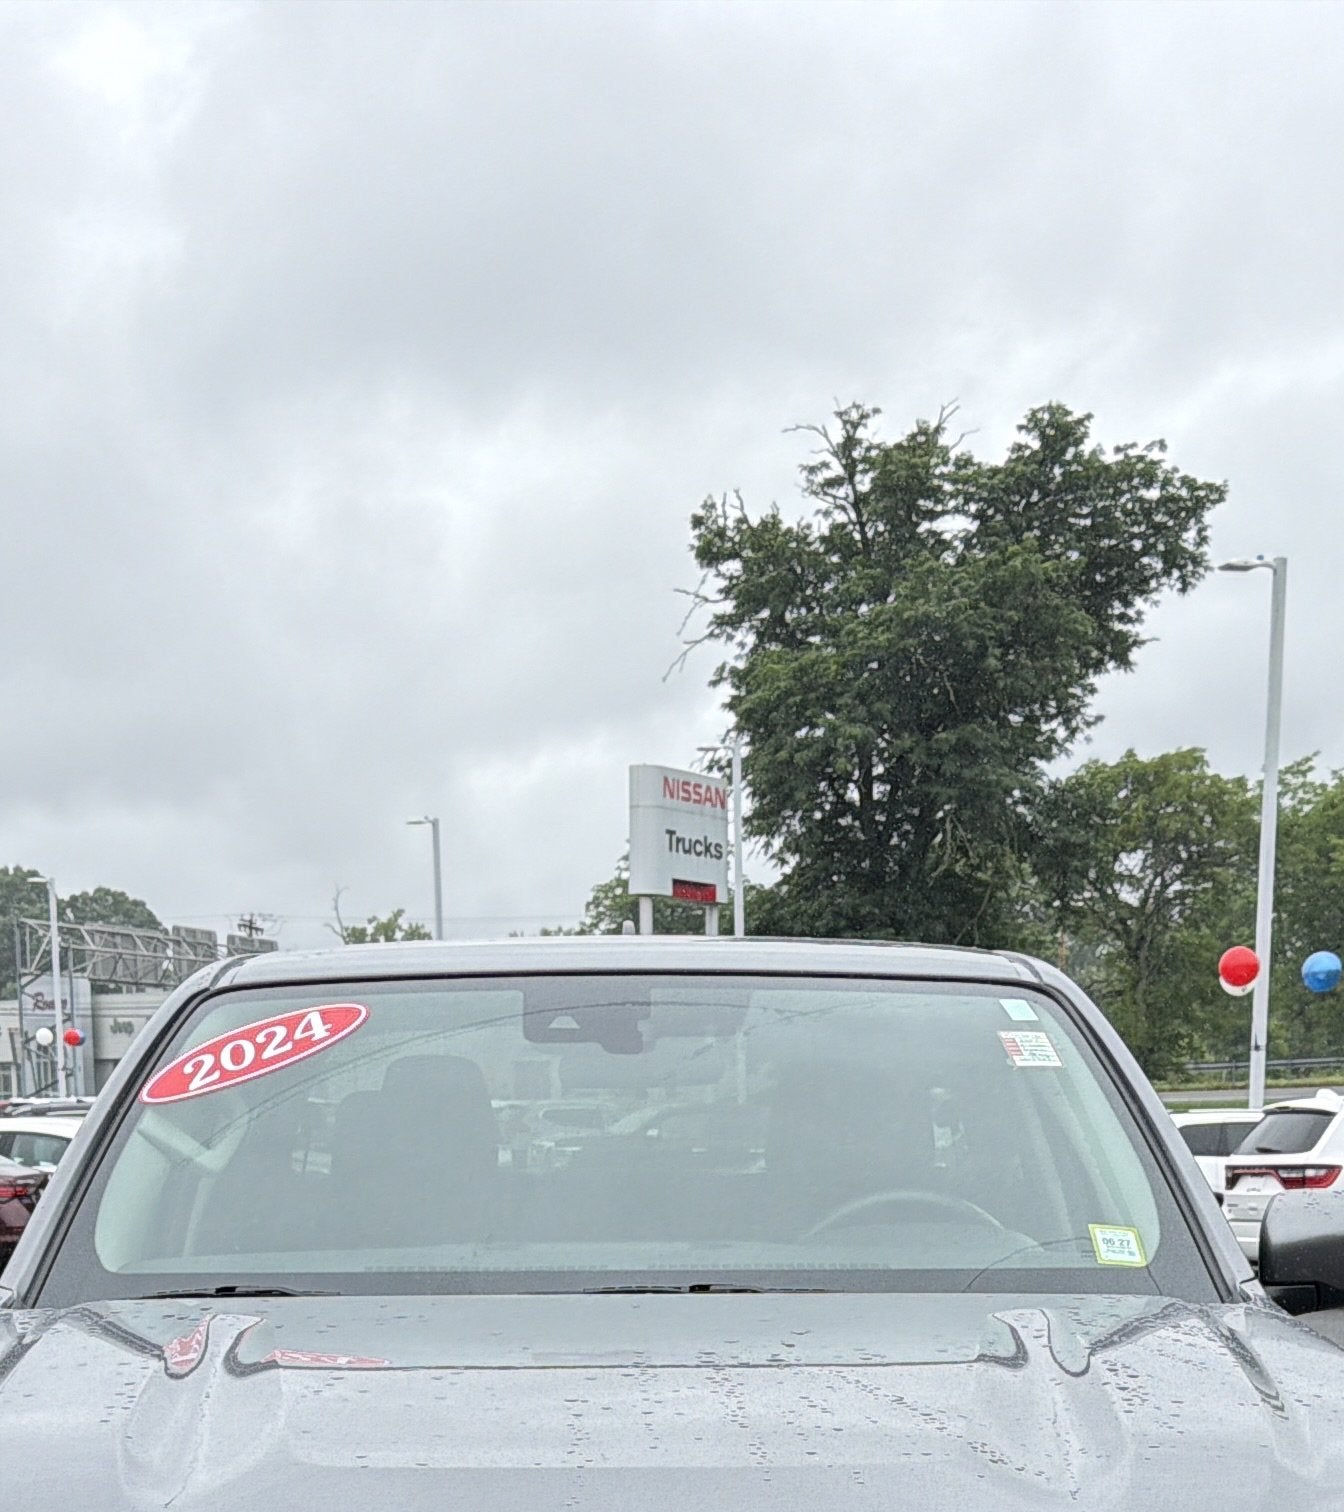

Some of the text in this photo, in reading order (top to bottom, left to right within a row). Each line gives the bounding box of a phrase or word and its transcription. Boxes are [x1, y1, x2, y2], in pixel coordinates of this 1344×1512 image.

[662, 776, 727, 809] NISSAN
[665, 828, 723, 860] Trucks
[182, 1011, 333, 1091] 2024
